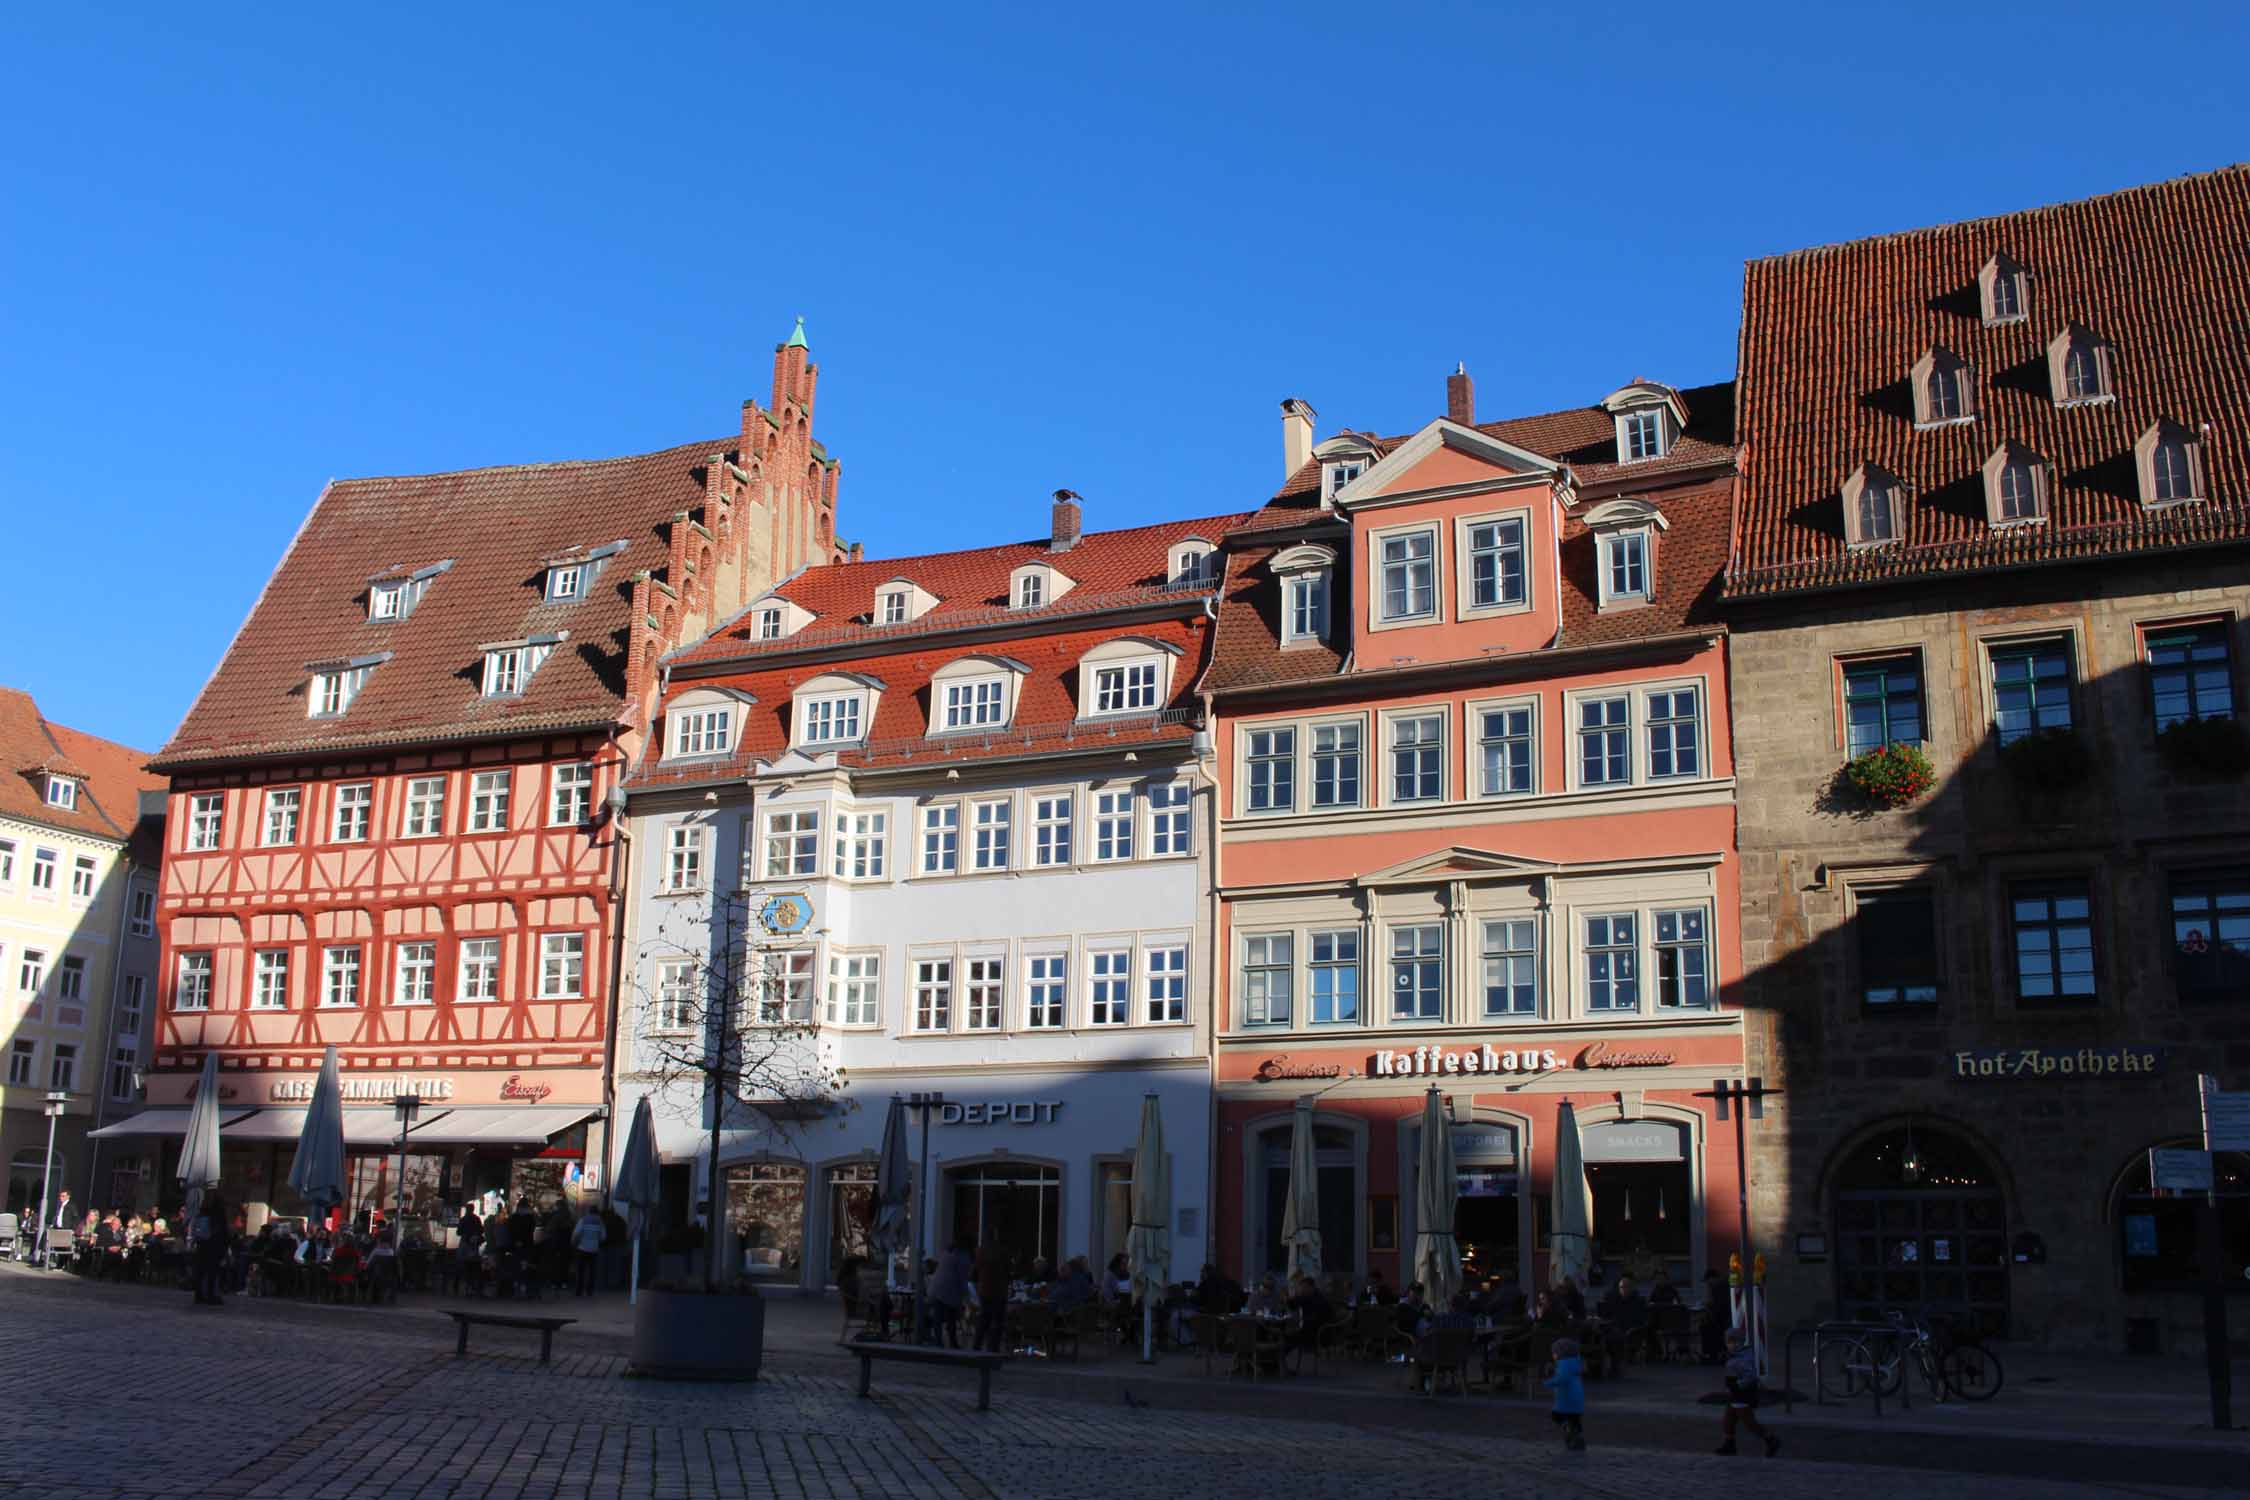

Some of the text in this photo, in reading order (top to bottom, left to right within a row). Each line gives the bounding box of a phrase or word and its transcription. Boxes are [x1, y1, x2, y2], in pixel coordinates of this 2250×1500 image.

[1375, 1044, 1556, 1075] Kaffeehaus
[1955, 1048, 2156, 1076] Hof-Apotheke
[941, 1101, 1062, 1125] DEPOT
